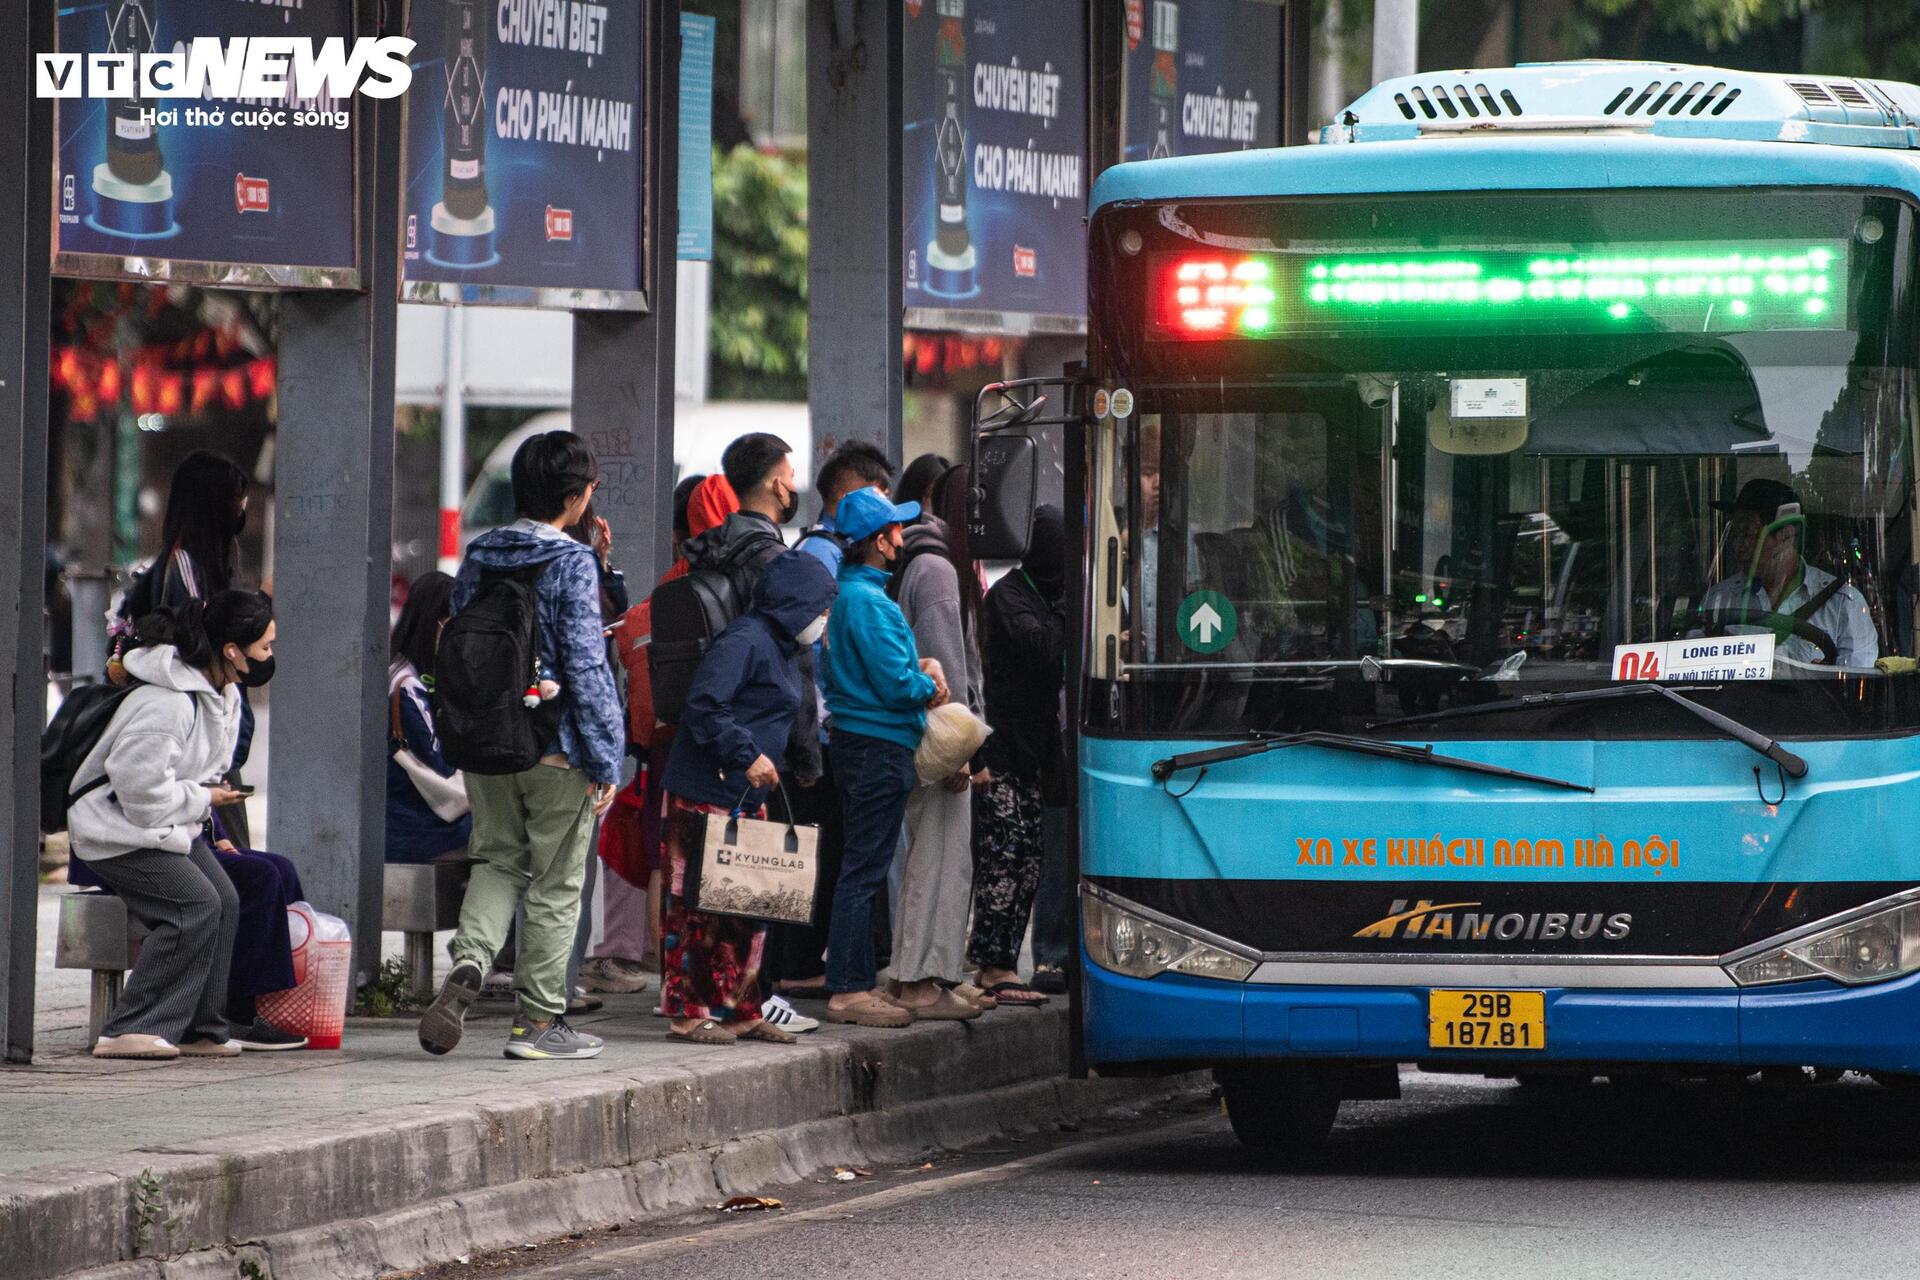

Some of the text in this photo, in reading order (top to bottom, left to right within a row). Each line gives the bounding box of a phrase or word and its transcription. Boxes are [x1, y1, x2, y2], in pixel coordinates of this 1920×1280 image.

[973, 56, 1060, 128] CHUYÊN BIỆT
[496, 80, 632, 162] CHO PHÁI MẠNH
[1182, 85, 1230, 138] CHUYÊN
[974, 138, 1079, 209] CHO PHÁI MẠNH
[1618, 651, 1660, 681] 04
[1682, 642, 1756, 659] LONG BIÊN
[1701, 666, 1720, 680] TIẾT
[1722, 668, 1736, 680] TW
[1744, 667, 1757, 679] CS
[1759, 667, 1766, 678] 2
[735, 852, 805, 870] KYUNGLAB
[1342, 838, 1377, 867] XE
[1386, 833, 1485, 867] KHÁCH
[1493, 839, 1564, 867] NAM
[1574, 835, 1614, 868] HÀ
[1622, 835, 1680, 875] NỘI
[1352, 899, 1633, 941] HANOIBUS
[1462, 994, 1512, 1018] 29B
[1445, 1021, 1530, 1046] 187.81
